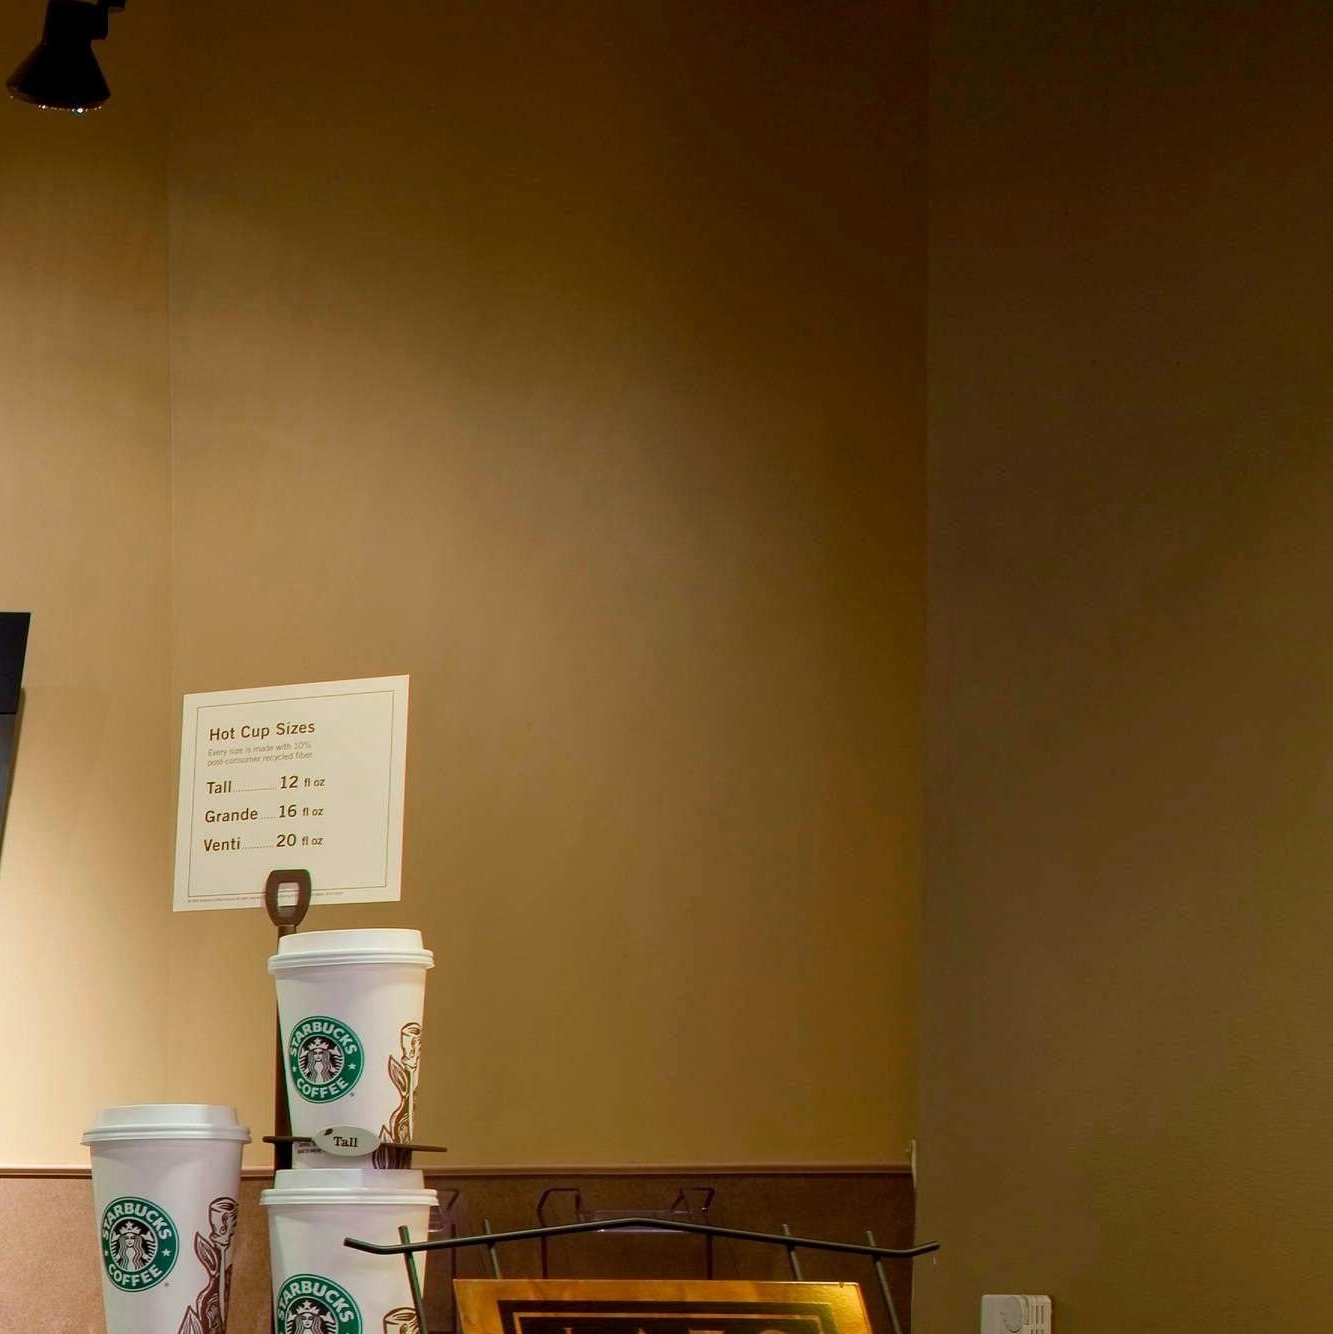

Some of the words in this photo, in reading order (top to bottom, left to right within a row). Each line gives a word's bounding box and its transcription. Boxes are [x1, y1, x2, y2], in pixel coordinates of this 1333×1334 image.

[209, 728, 235, 741] Hot
[241, 726, 269, 739] Cup
[276, 722, 315, 735] Sizes
[207, 781, 231, 794] Tall
[280, 776, 298, 789] 12
[304, 778, 310, 787] fl
[314, 779, 325, 787] oz
[205, 808, 258, 823] Grande
[278, 805, 297, 818] 16
[303, 807, 309, 816] fl
[312, 808, 323, 816] oz
[204, 838, 241, 852] Venti
[277, 834, 296, 847] 20
[302, 837, 308, 845] fl
[290, 1021, 358, 1058] STARBUCKS
[296, 1077, 348, 1100] COFFEE
[333, 1134, 358, 1148] Tall
